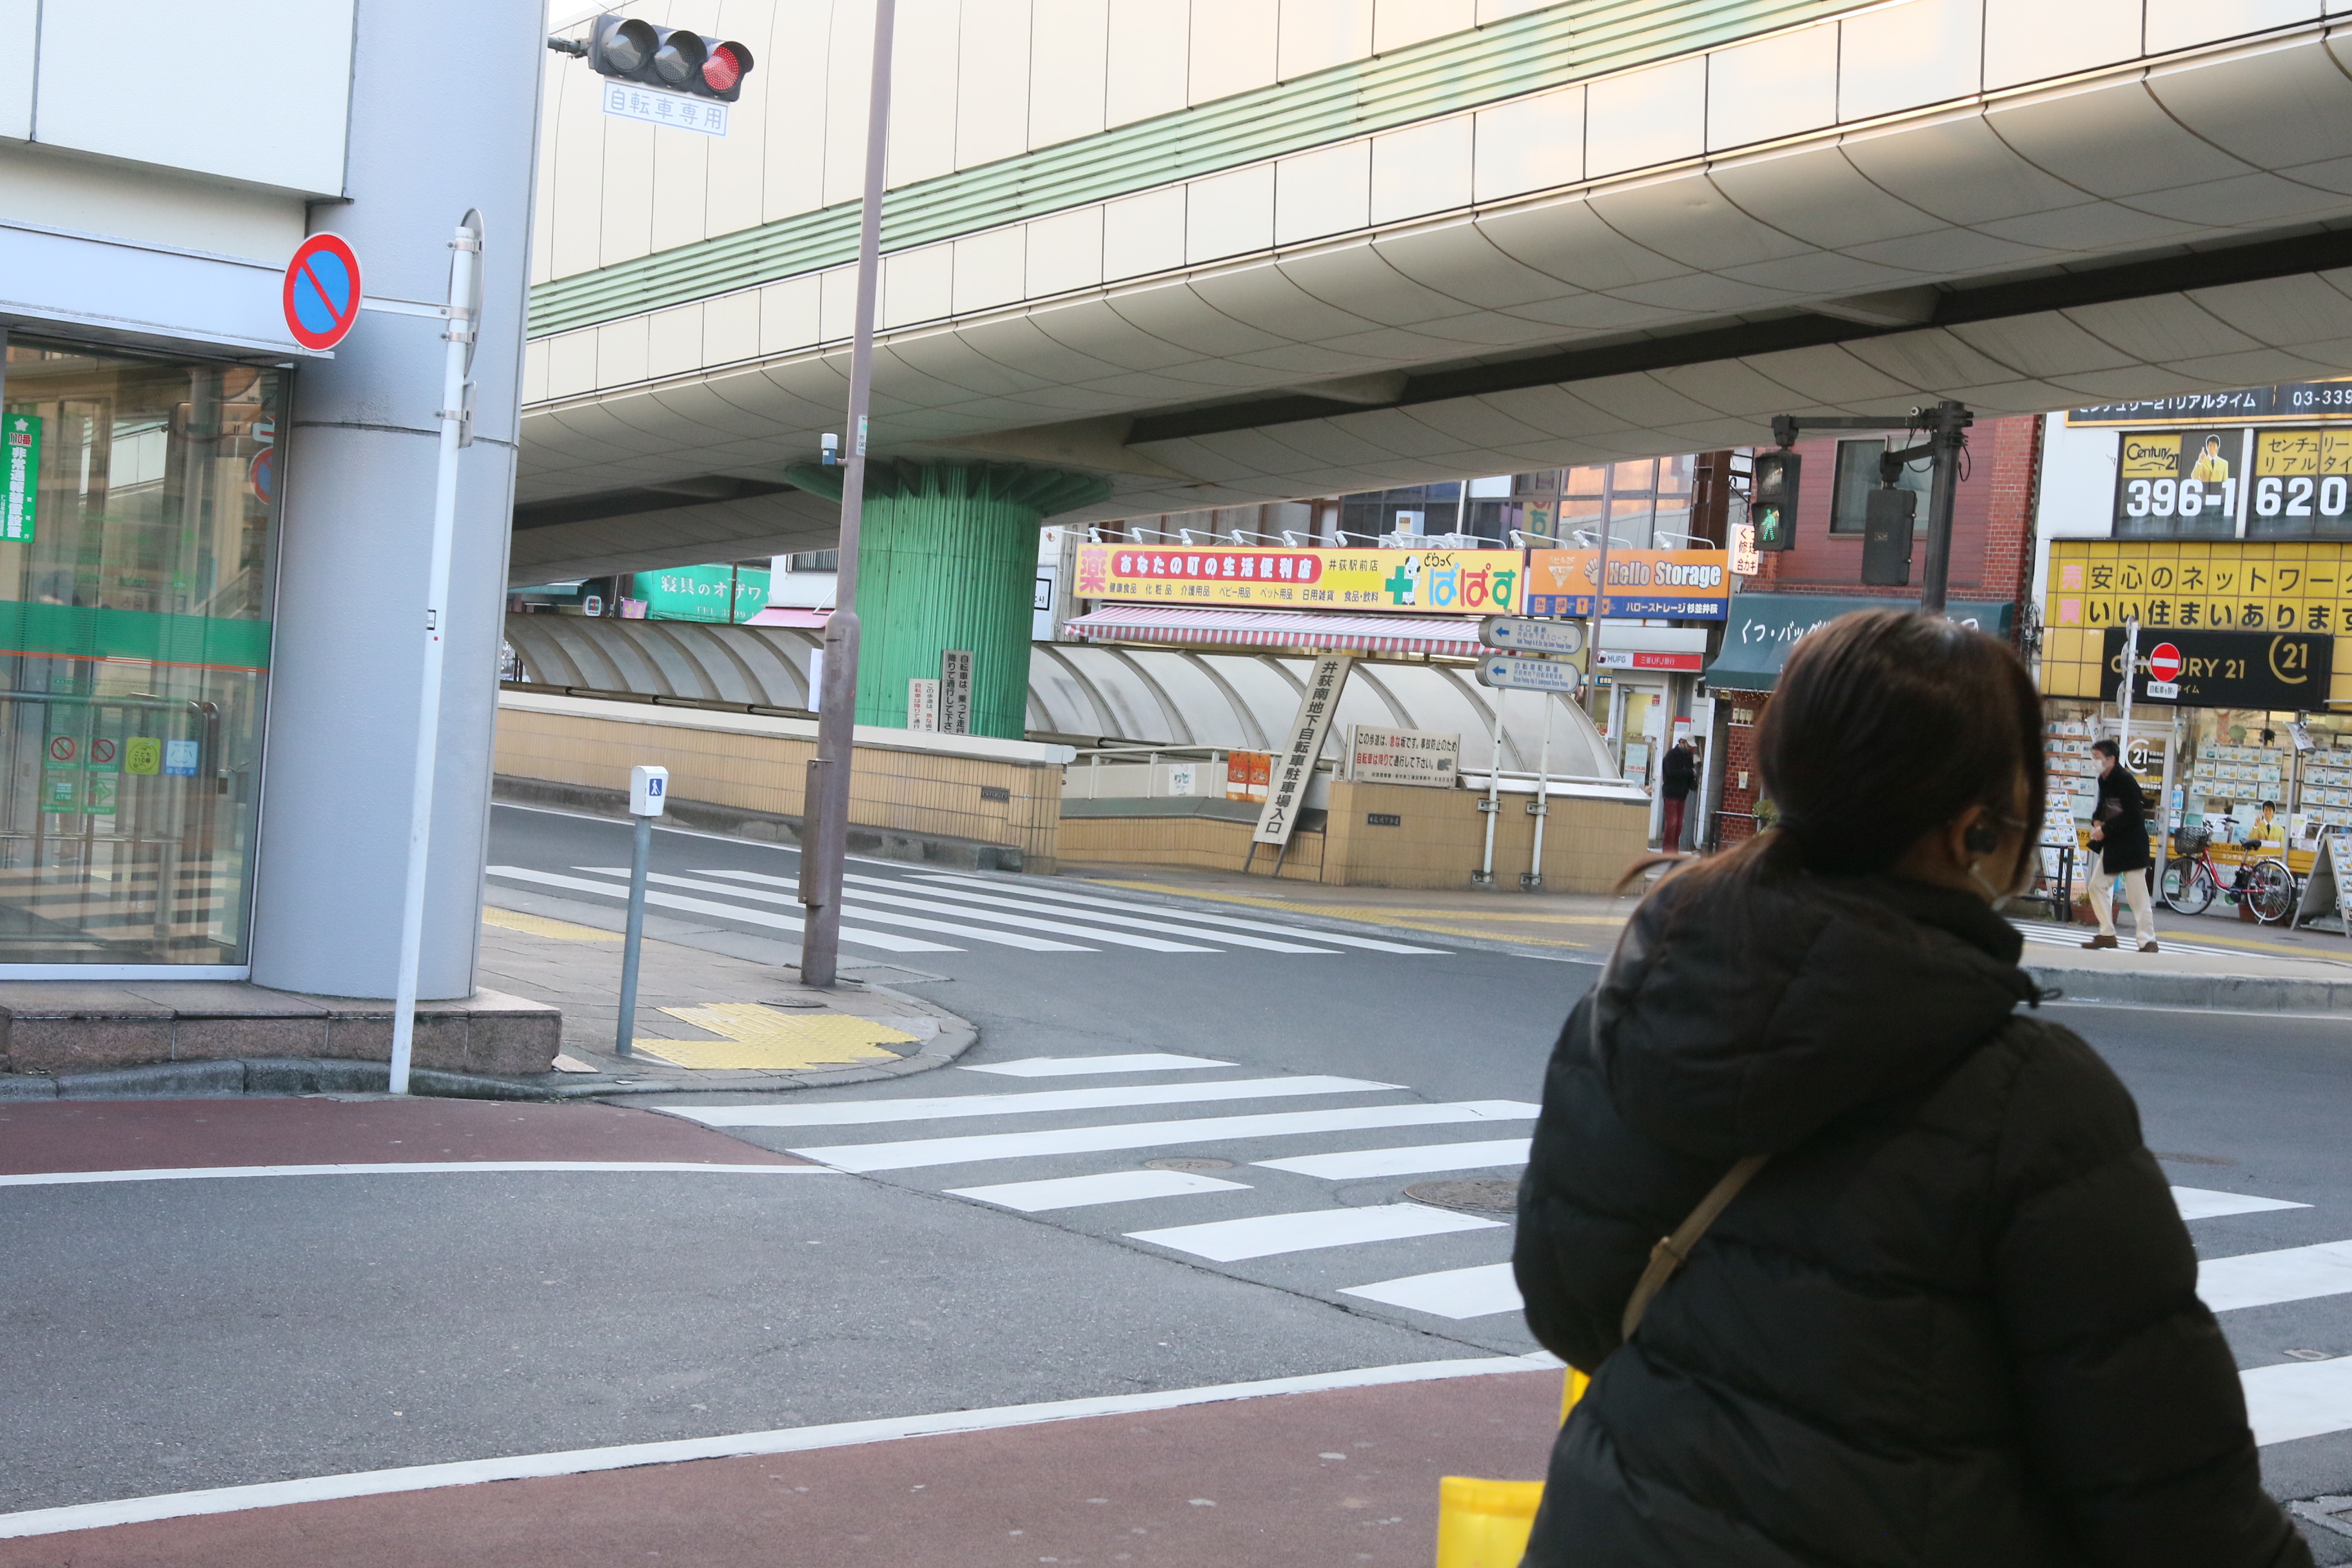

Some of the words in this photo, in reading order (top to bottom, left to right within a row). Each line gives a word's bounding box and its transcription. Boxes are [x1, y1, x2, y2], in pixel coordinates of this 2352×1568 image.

[610, 88, 722, 130] 自転車専用
[2268, 436, 2349, 453] センチュリー
[2126, 478, 2237, 516] 396-1
[2256, 477, 2347, 516] 620
[1120, 554, 1313, 580] あなたの町の生活便利店
[1328, 558, 1378, 572] 井荻駅前店
[1424, 553, 1455, 567] どらっぐ
[1079, 548, 1108, 594] 薬
[1607, 560, 1651, 586] Hello
[1654, 560, 1722, 589] Storage
[661, 574, 762, 601] 寝具のオザワ
[1109, 582, 1137, 594] 健康食品
[1145, 583, 1172, 595] 化粧品
[1181, 585, 1210, 597] 介護用品
[1219, 586, 1251, 598] ベビー用品
[1260, 587, 1293, 600] ペット用品
[1302, 589, 1335, 601] 日用雑貨
[1344, 590, 1378, 603] 食品・飲料
[1429, 562, 1516, 610] ぱぱす
[721, 608, 746, 619] 399
[1626, 602, 1686, 614] ハローストレージ
[1687, 603, 1718, 615] 杉並井荻
[1514, 662, 1558, 673] 自転車駐車場
[1607, 655, 1626, 663] MUFG
[1640, 656, 1675, 665] 三菱UFJ銀行
[2224, 659, 2246, 680] 21
[1265, 661, 1339, 834] 井荻南地下自転車駐車場入口
[1358, 732, 1457, 753] この歩道は、急な坂です。事故防止のため
[1356, 752, 1434, 770] 自転車は降りて通行して下さい。
